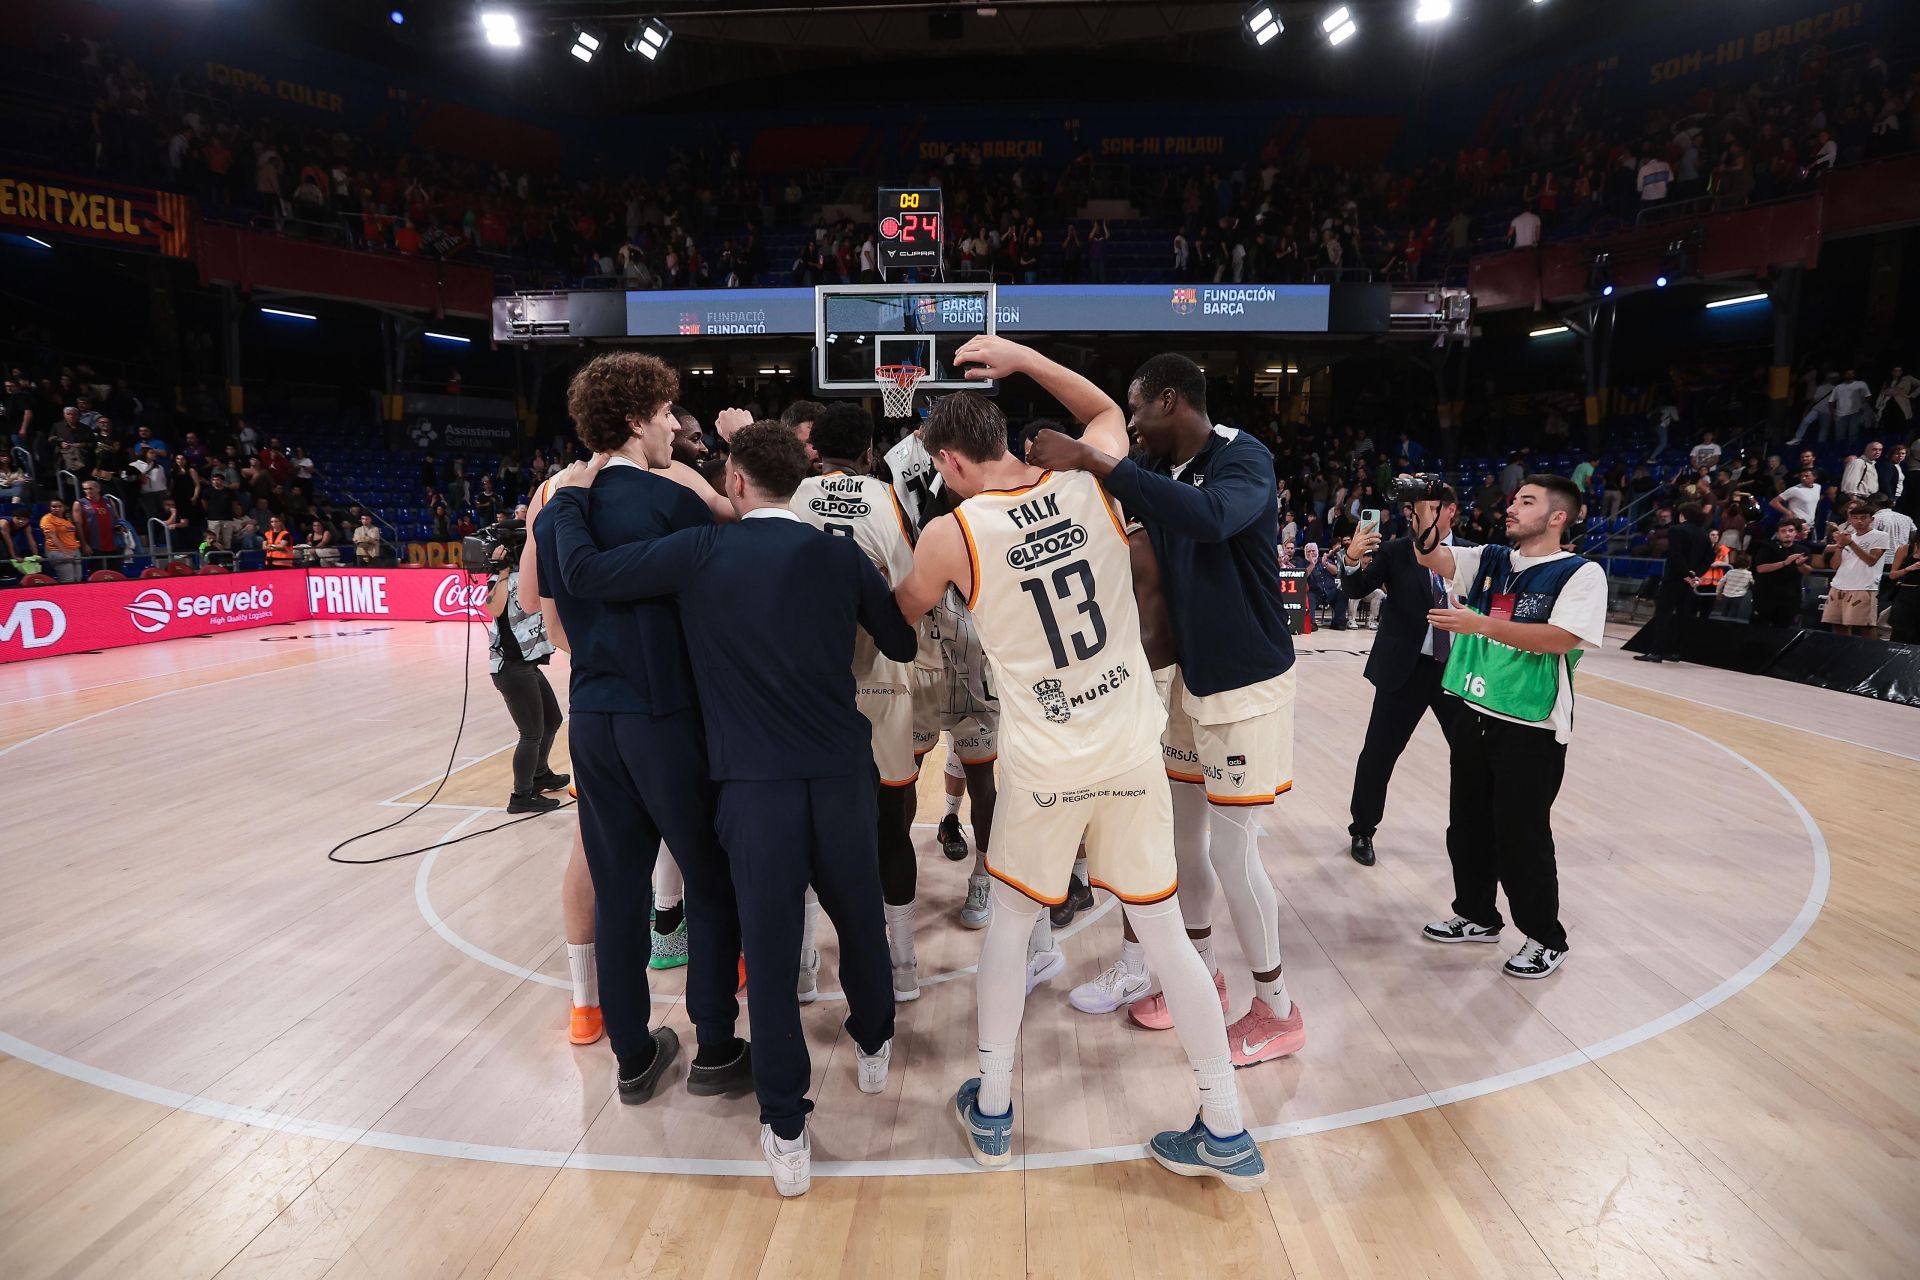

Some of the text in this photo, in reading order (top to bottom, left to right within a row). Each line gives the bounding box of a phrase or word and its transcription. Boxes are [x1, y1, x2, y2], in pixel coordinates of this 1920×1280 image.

[900, 193, 919, 208] 0:0
[902, 215, 937, 241] 24
[1204, 287, 1276, 302] FUNDACIÓN
[942, 299, 984, 312] BARÇA
[1203, 302, 1245, 316] BARÇA
[707, 322, 766, 335] FUNDACIÓ
[1007, 493, 1060, 529] FALK
[177, 585, 274, 618] serveto
[306, 575, 389, 614] PRIME
[209, 617, 225, 625] High
[226, 614, 248, 622] Quality
[1020, 559, 1107, 669] 13
[1070, 668, 1130, 708] MURCIA
[1464, 671, 1486, 698] 16
[1161, 743, 1199, 763] VERSUS
[1112, 789, 1146, 797] MURCIA
